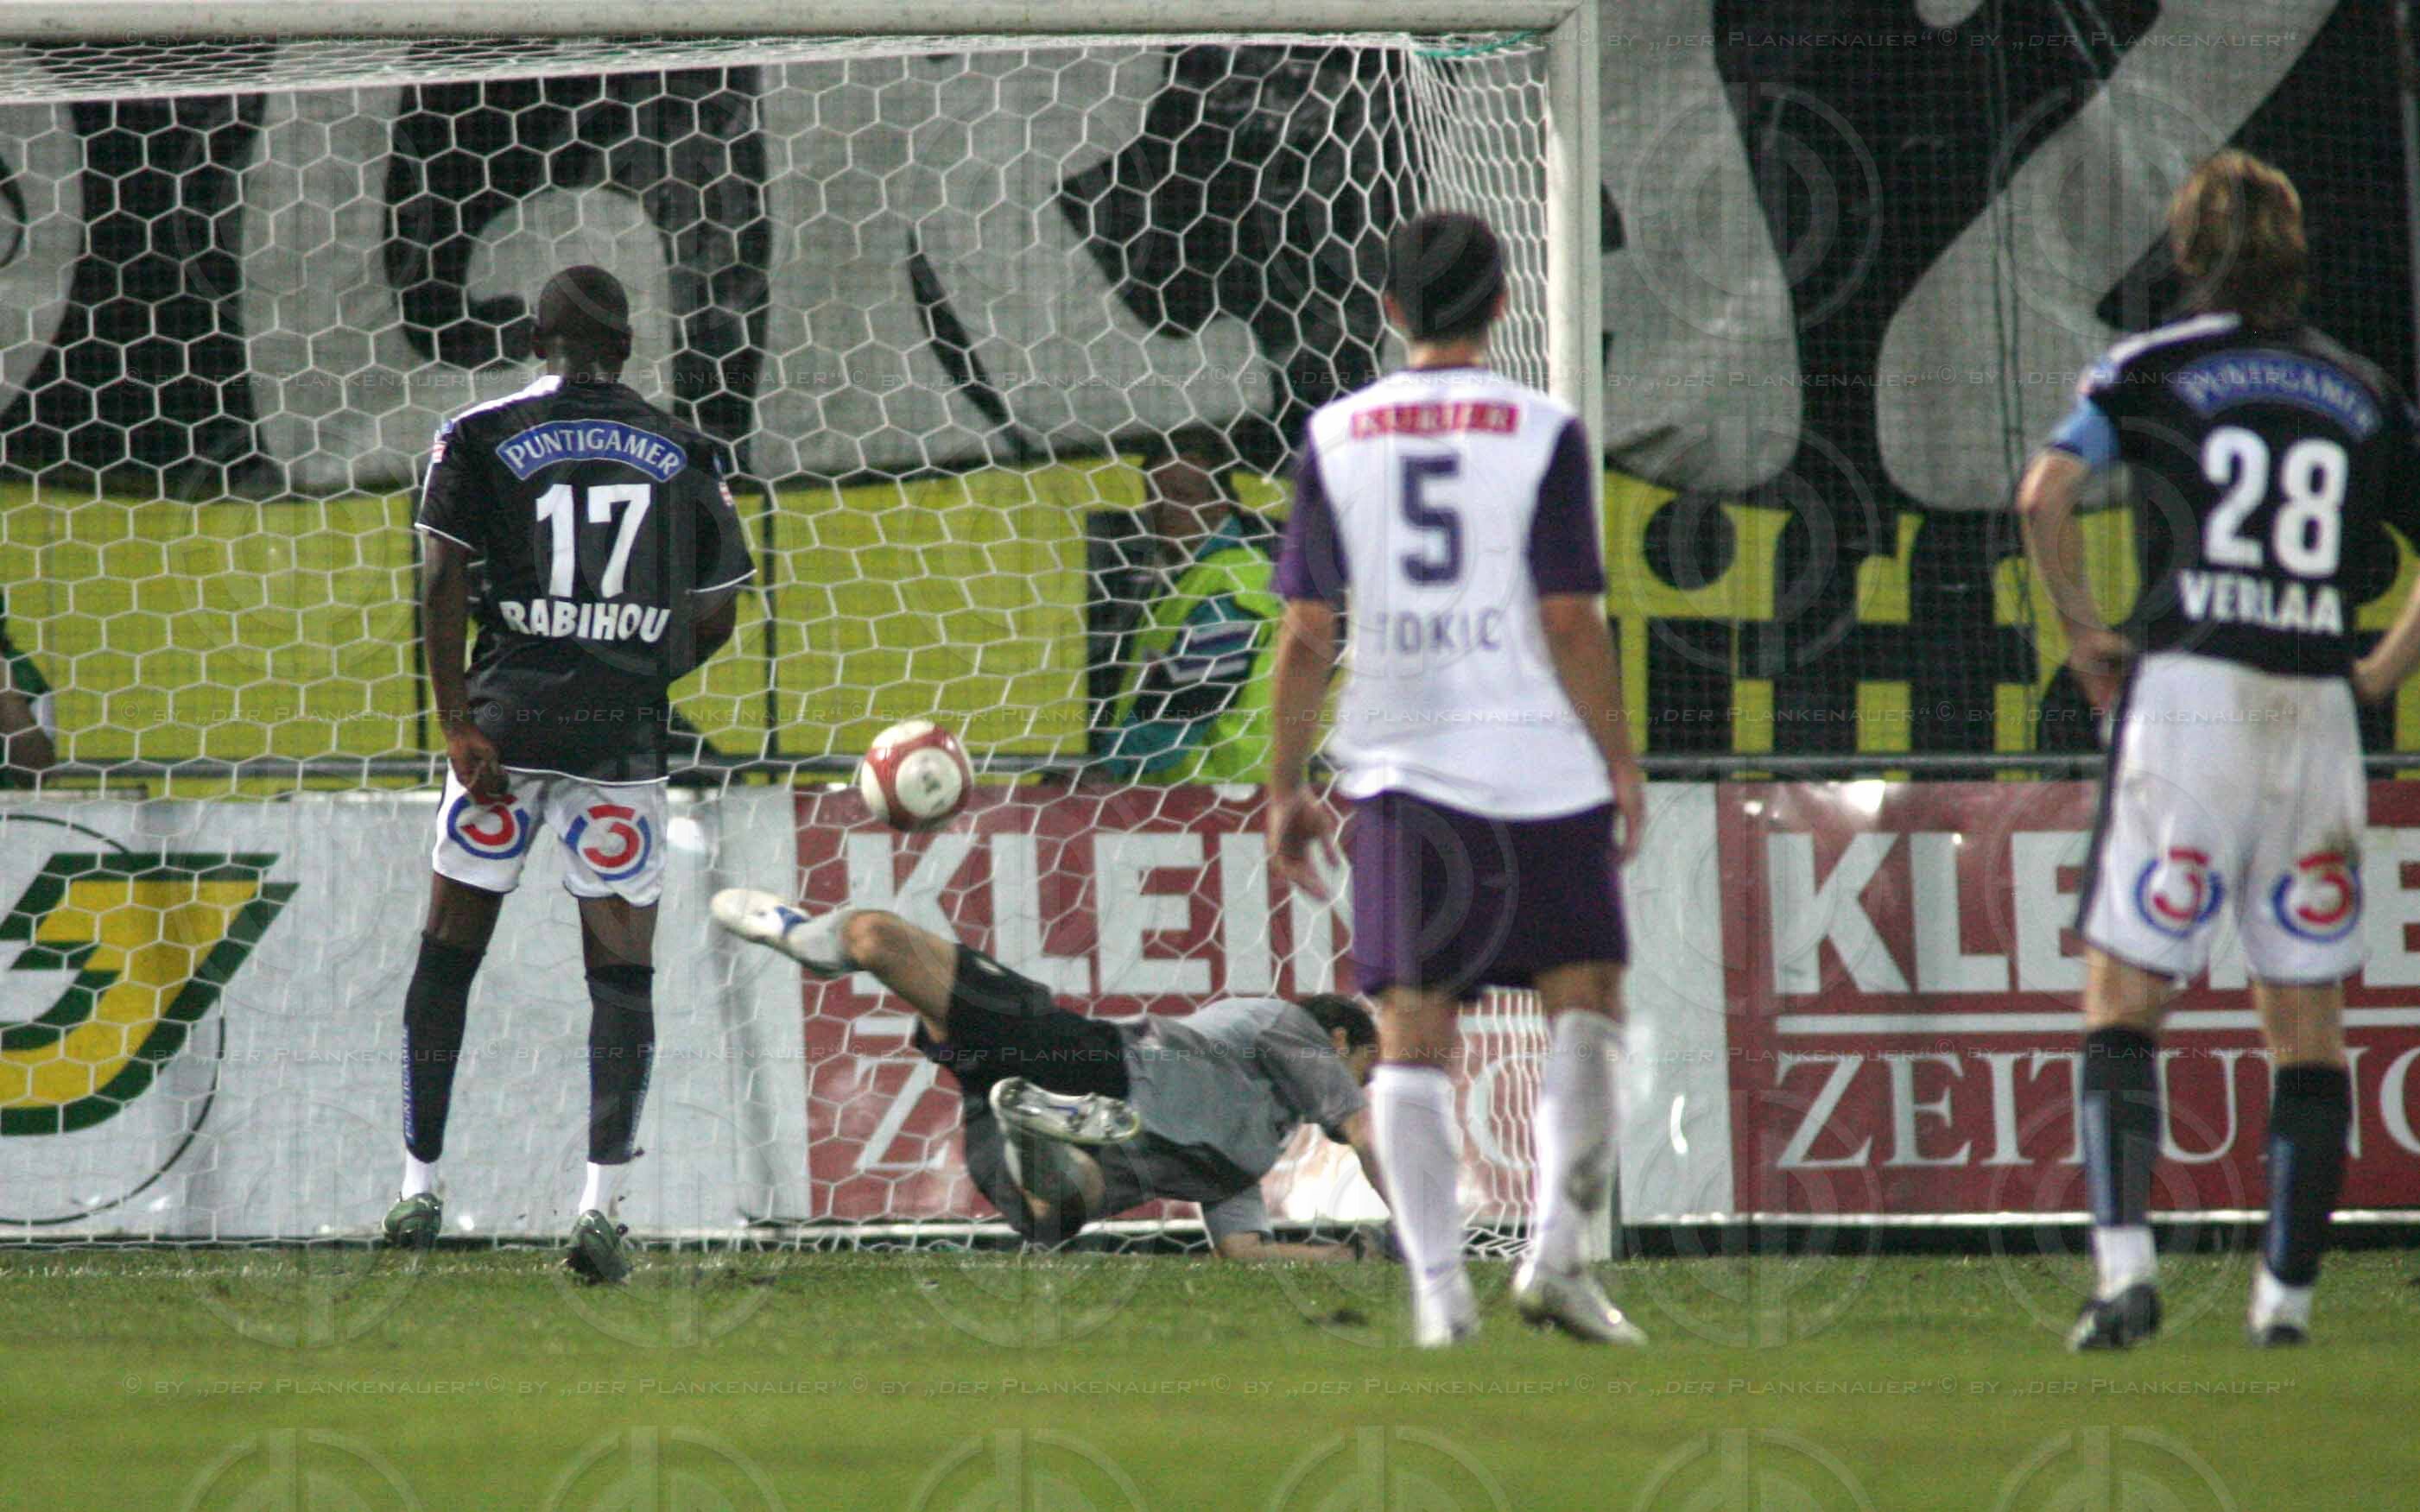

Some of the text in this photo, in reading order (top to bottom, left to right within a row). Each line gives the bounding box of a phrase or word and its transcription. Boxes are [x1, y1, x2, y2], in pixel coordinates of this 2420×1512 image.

[505, 427, 681, 476] PUNTIGAMER
[2202, 425, 2349, 579] 28
[535, 483, 650, 598] 17
[1400, 452, 1463, 587] 5
[499, 598, 671, 642] RABIHOU
